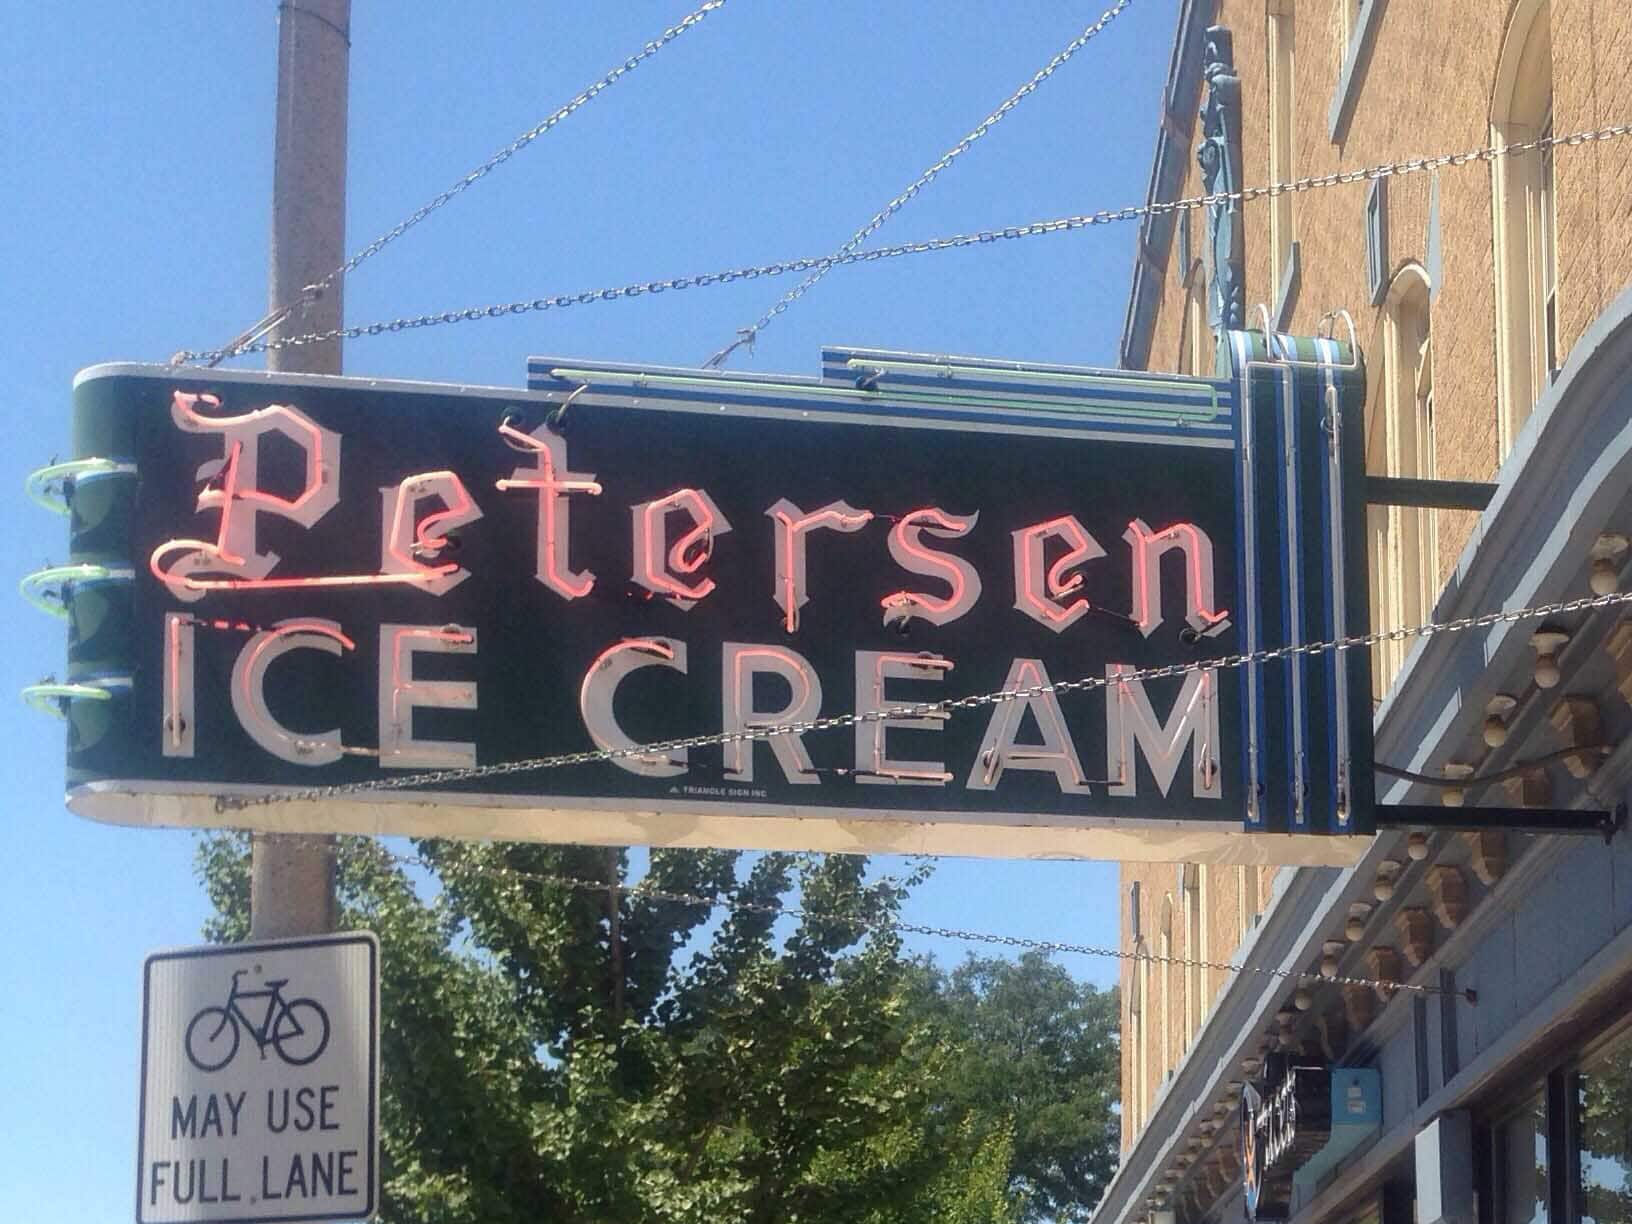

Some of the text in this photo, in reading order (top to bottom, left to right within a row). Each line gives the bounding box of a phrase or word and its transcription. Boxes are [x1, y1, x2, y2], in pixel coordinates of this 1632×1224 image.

[150, 390, 1231, 640] Petersen
[162, 612, 1222, 799] ICE CREAM
[683, 786, 767, 798] TRIANGLE SIGN INC
[171, 1085, 340, 1140] MAY USE
[150, 1151, 358, 1205] FULL LANE
